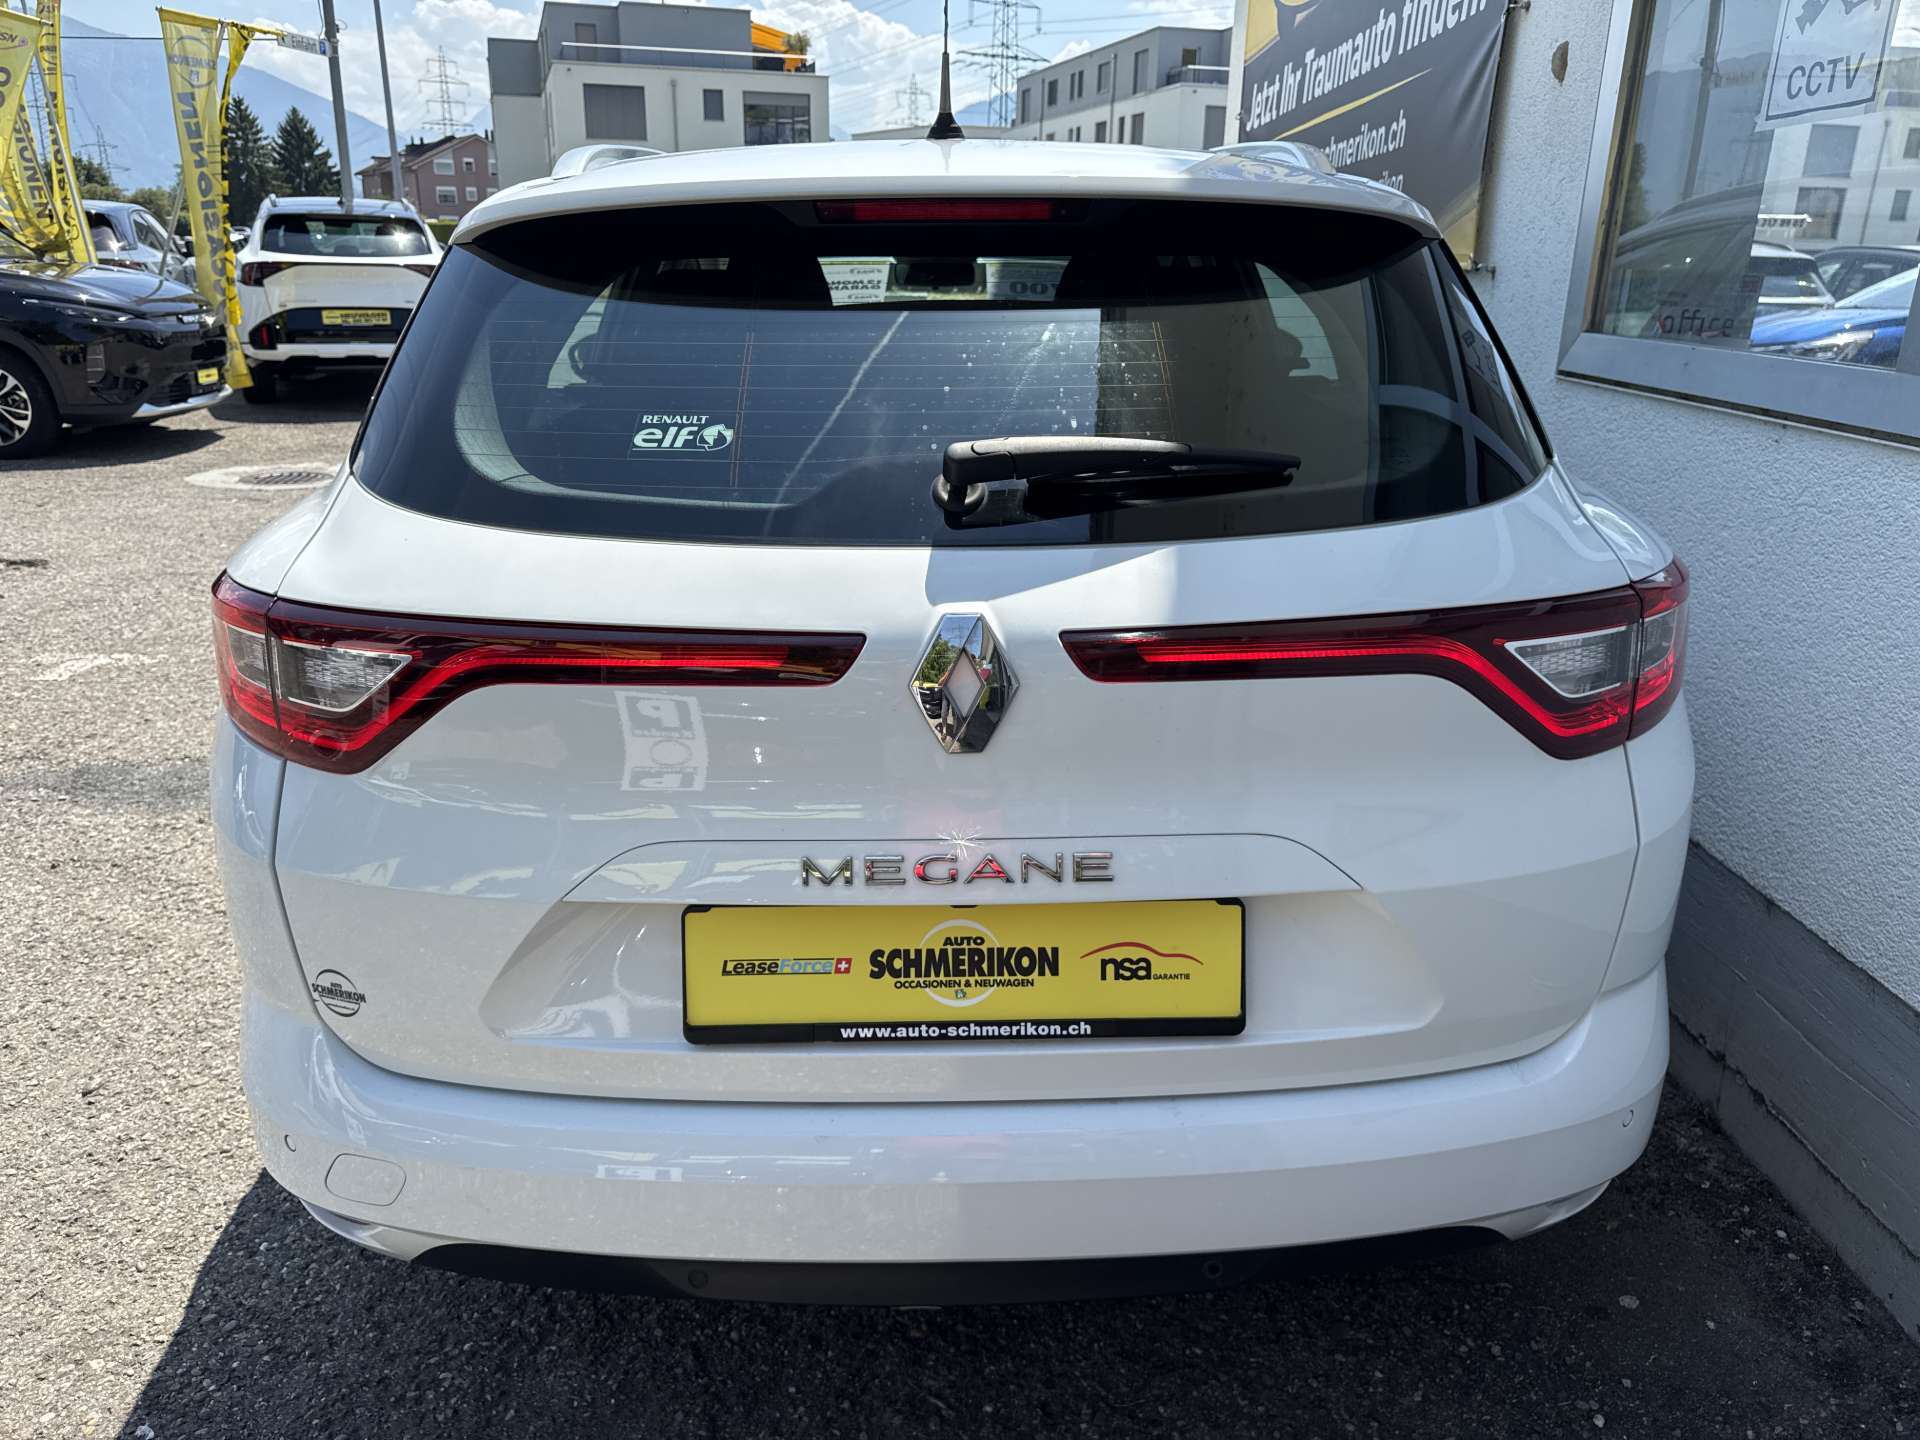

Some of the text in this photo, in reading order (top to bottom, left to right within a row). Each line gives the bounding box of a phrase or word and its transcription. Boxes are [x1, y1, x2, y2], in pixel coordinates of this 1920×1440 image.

[1246, 0, 1487, 131] Jetzt Ihr Traumauto finden
[1786, 52, 1866, 100] CCTV
[1321, 109, 1407, 168] hmerikon.ch
[1661, 309, 1735, 337] office
[642, 414, 709, 425] RENAULT
[633, 426, 698, 448] elf
[801, 851, 1114, 887] MEGANE
[943, 936, 985, 947] AUTO
[722, 959, 834, 975] LeaseForce
[869, 946, 1060, 980] SCHMERIKON
[1100, 957, 1191, 981] nsa GARANTIE
[311, 983, 367, 1003] SCHMERIKON
[894, 978, 1035, 989] OCCASIONEN & NEUWAGEN
[840, 1021, 1092, 1039] www.auto-schmerikon.ch
